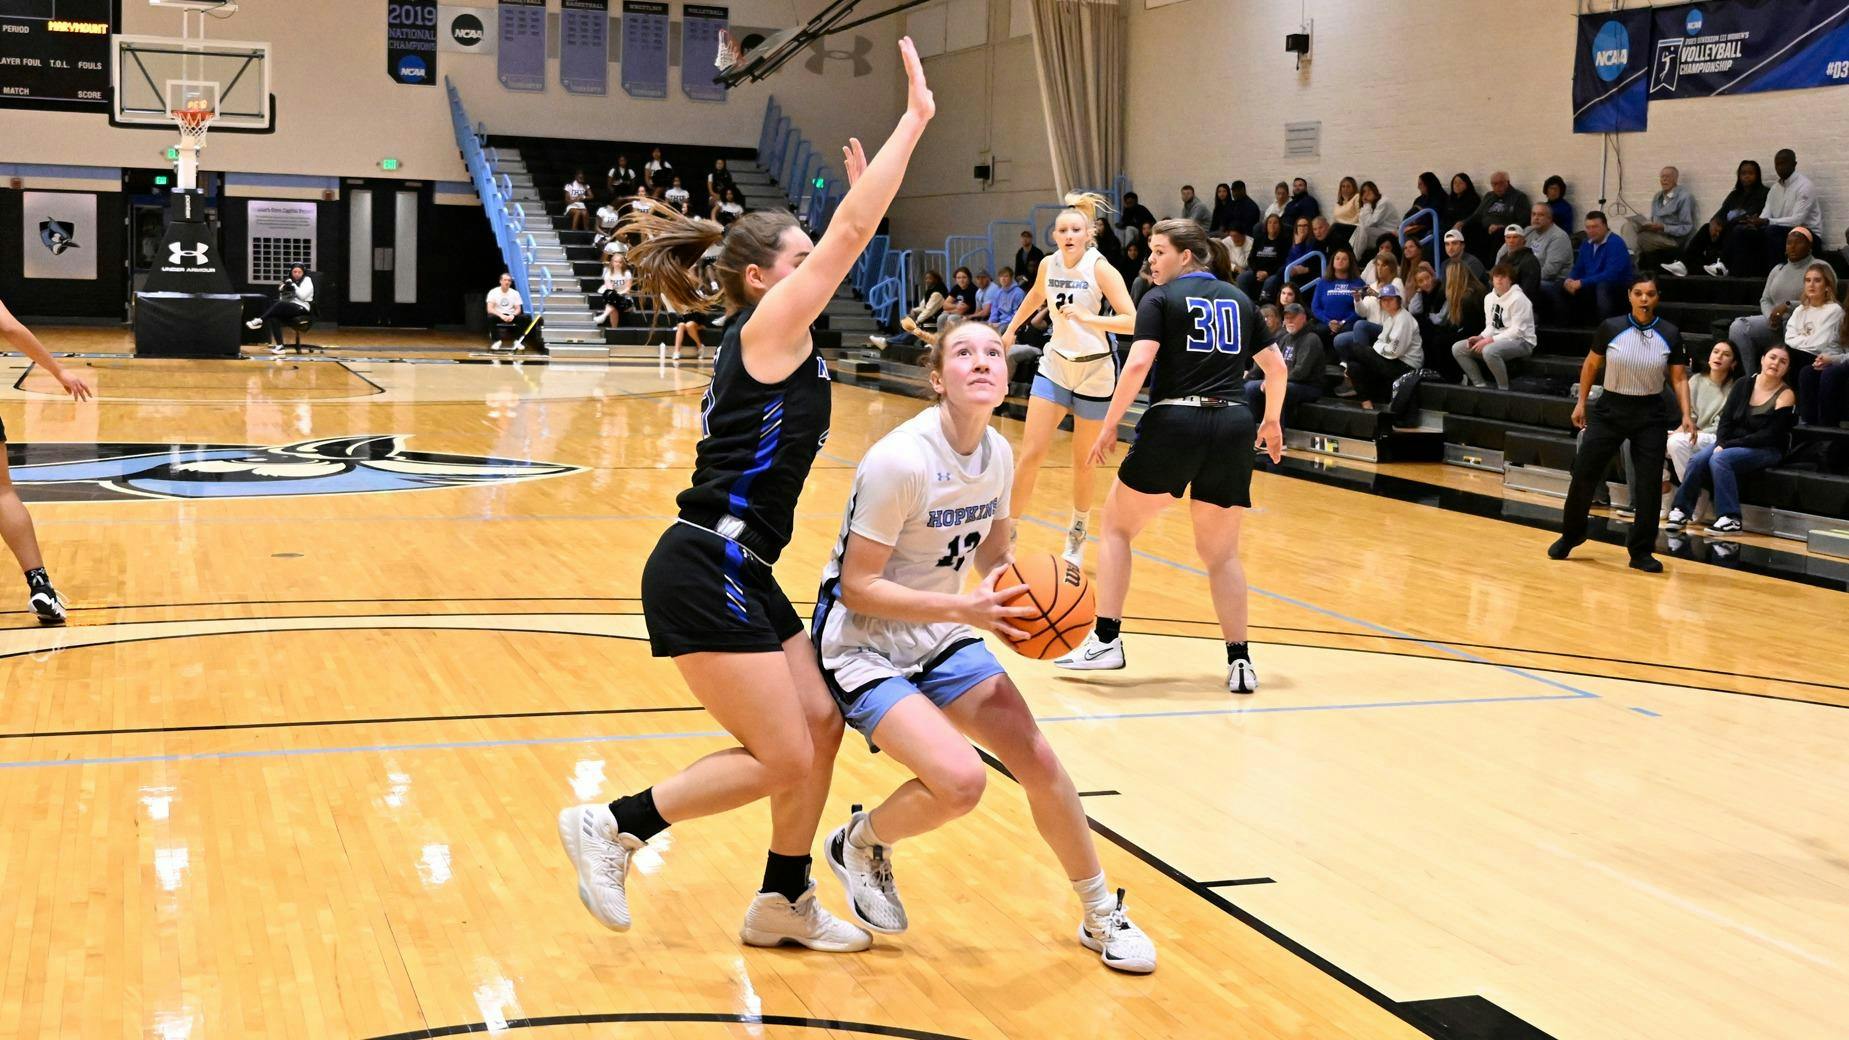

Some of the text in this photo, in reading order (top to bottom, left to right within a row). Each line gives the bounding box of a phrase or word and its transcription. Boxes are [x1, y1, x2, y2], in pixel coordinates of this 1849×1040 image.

[389, 5, 437, 26] 2019
[2, 25, 30, 34] PERIOD
[454, 29, 483, 38] NCAA
[1681, 41, 1742, 62] VOLLEYBALL
[23, 58, 43, 67] FOUL
[1595, 49, 1628, 66] NCAA
[78, 61, 103, 70] FOULS
[1680, 60, 1733, 75] CHAMPIONSHIP
[400, 67, 426, 77] NCAA
[3, 86, 30, 95] MATCH
[77, 90, 103, 99] SCORE
[1185, 296, 1241, 355] 30
[926, 497, 998, 528] HOPKIN
